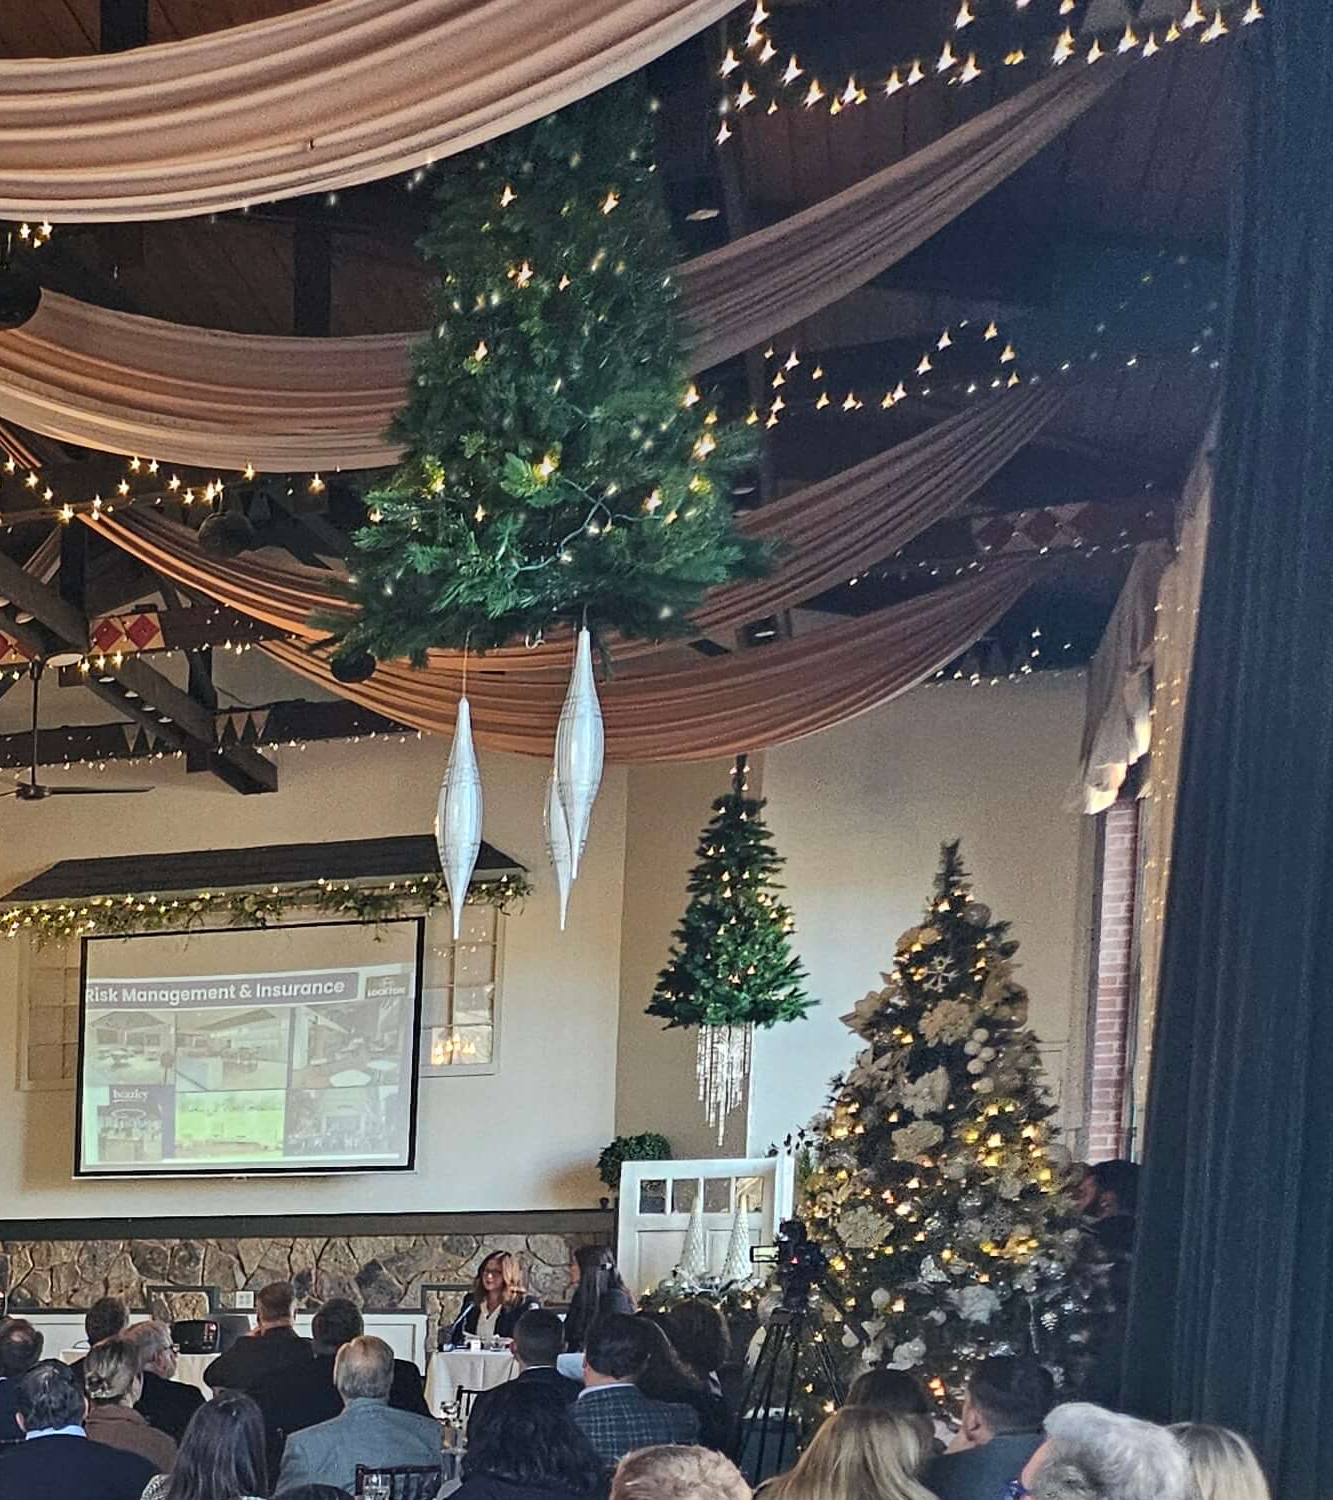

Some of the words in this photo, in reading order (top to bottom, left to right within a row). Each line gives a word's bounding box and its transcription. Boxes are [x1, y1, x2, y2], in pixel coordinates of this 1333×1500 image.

[85, 987, 118, 1003] Risk
[122, 984, 236, 1006] Management
[239, 984, 252, 998] &
[256, 981, 345, 998] Insurance
